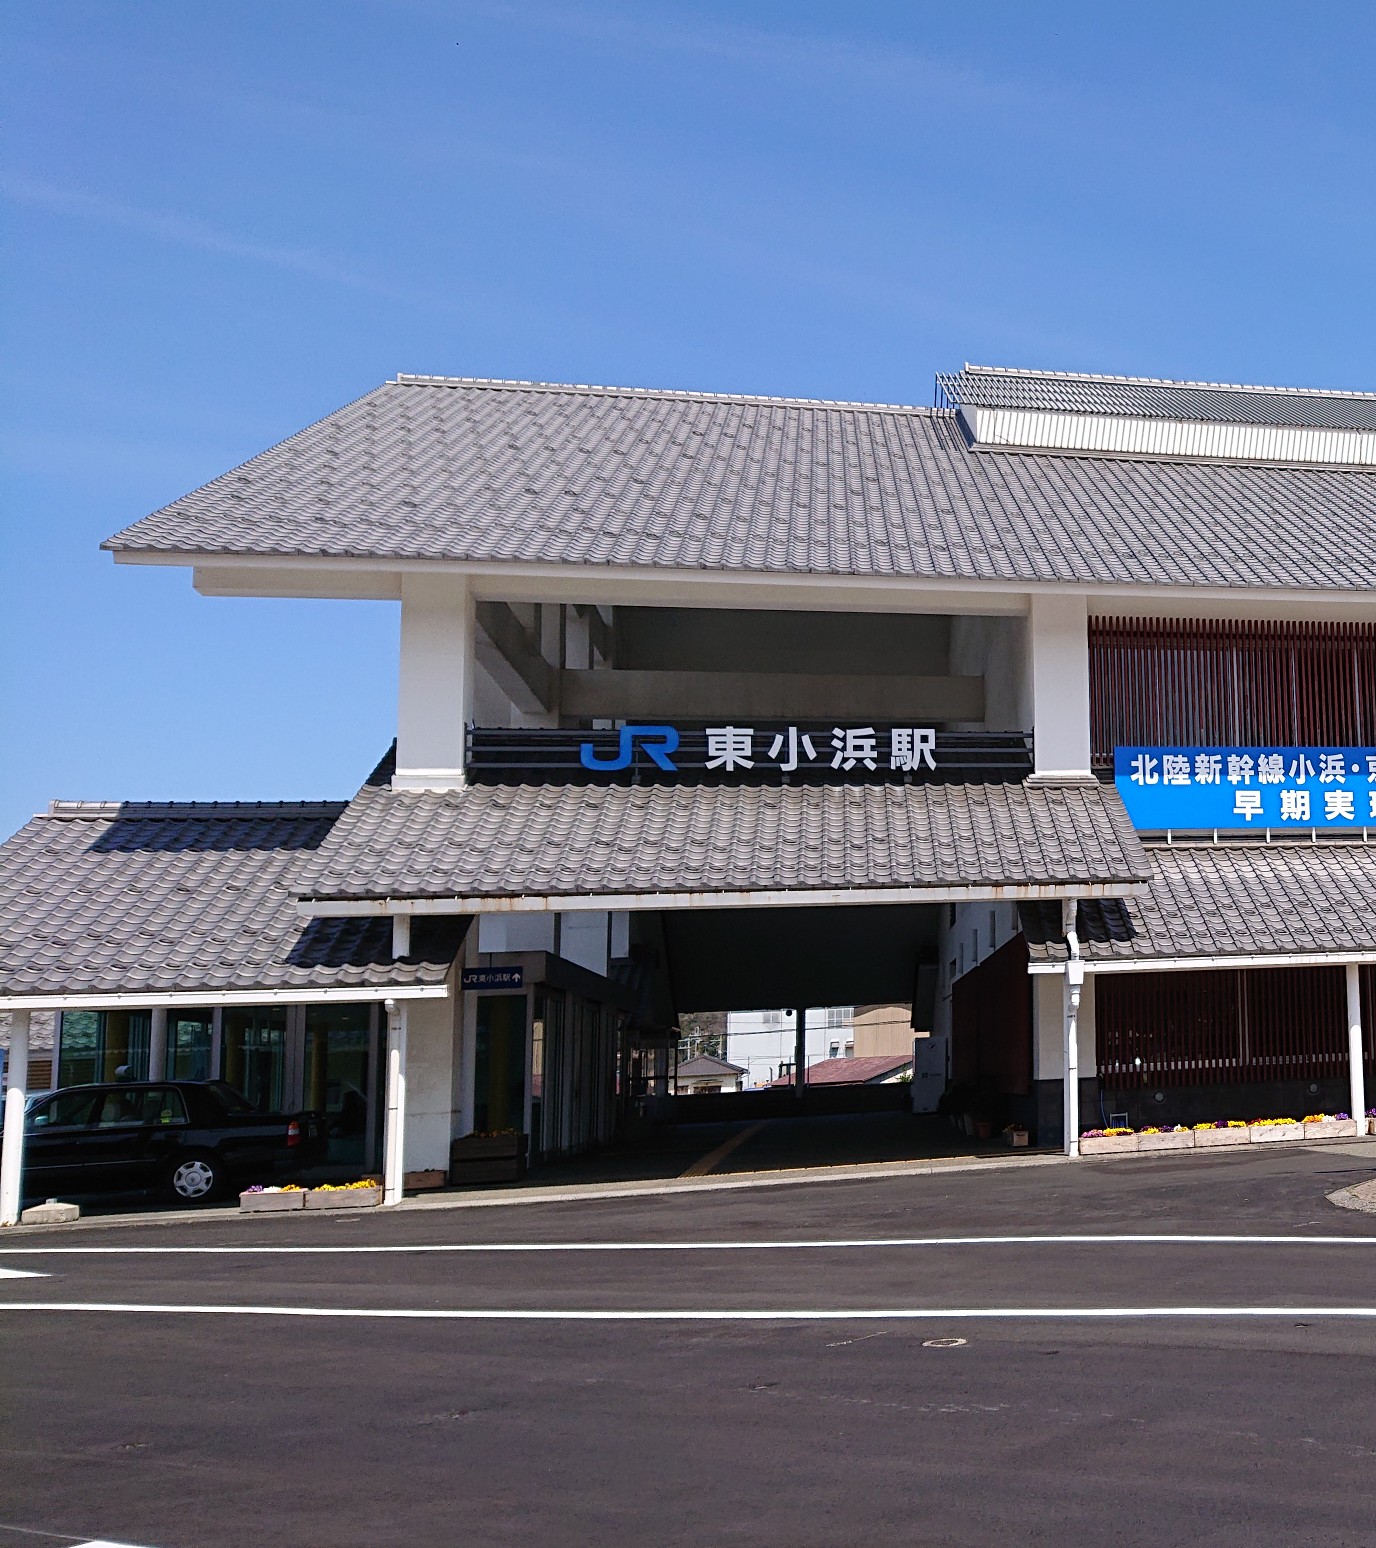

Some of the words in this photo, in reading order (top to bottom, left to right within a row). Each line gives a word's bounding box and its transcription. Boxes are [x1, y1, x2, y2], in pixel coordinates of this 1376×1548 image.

[580, 725, 680, 772] JR
[704, 725, 938, 772] 東小浜駅
